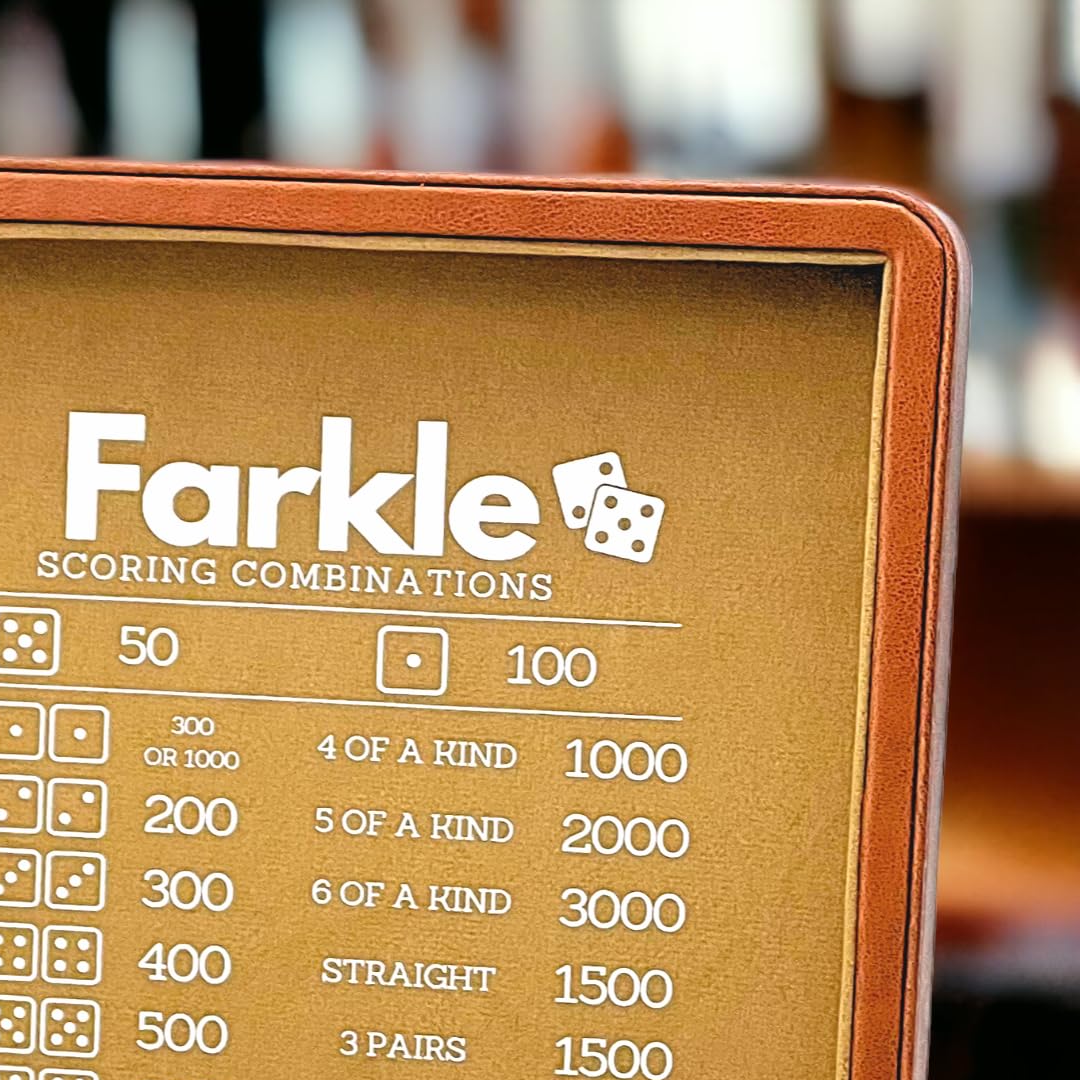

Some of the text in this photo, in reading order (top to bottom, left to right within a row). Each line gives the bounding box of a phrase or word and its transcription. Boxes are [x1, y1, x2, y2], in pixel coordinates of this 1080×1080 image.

[66, 412, 540, 560] Farkle
[38, 551, 552, 600] SCORING COMBINATIONS
[119, 626, 179, 666] 50
[508, 646, 597, 687] 100
[172, 716, 214, 736] 300
[144, 747, 240, 769] OR 1000
[317, 735, 517, 768] 4 OF A KIND
[566, 739, 687, 782] 1000
[144, 795, 238, 836] 200
[315, 808, 513, 842] 5 OF A KIND
[562, 814, 689, 858] 2000
[142, 870, 233, 911] 300
[312, 879, 511, 914] 6 OF A KIND
[559, 889, 685, 932] 3000
[138, 943, 231, 984] 400
[322, 958, 496, 991] STRAIGHT
[555, 965, 672, 1008] 1500
[137, 1012, 228, 1053] 500
[340, 1031, 466, 1061] 3 PAIRS
[555, 1037, 672, 1080] 1500
